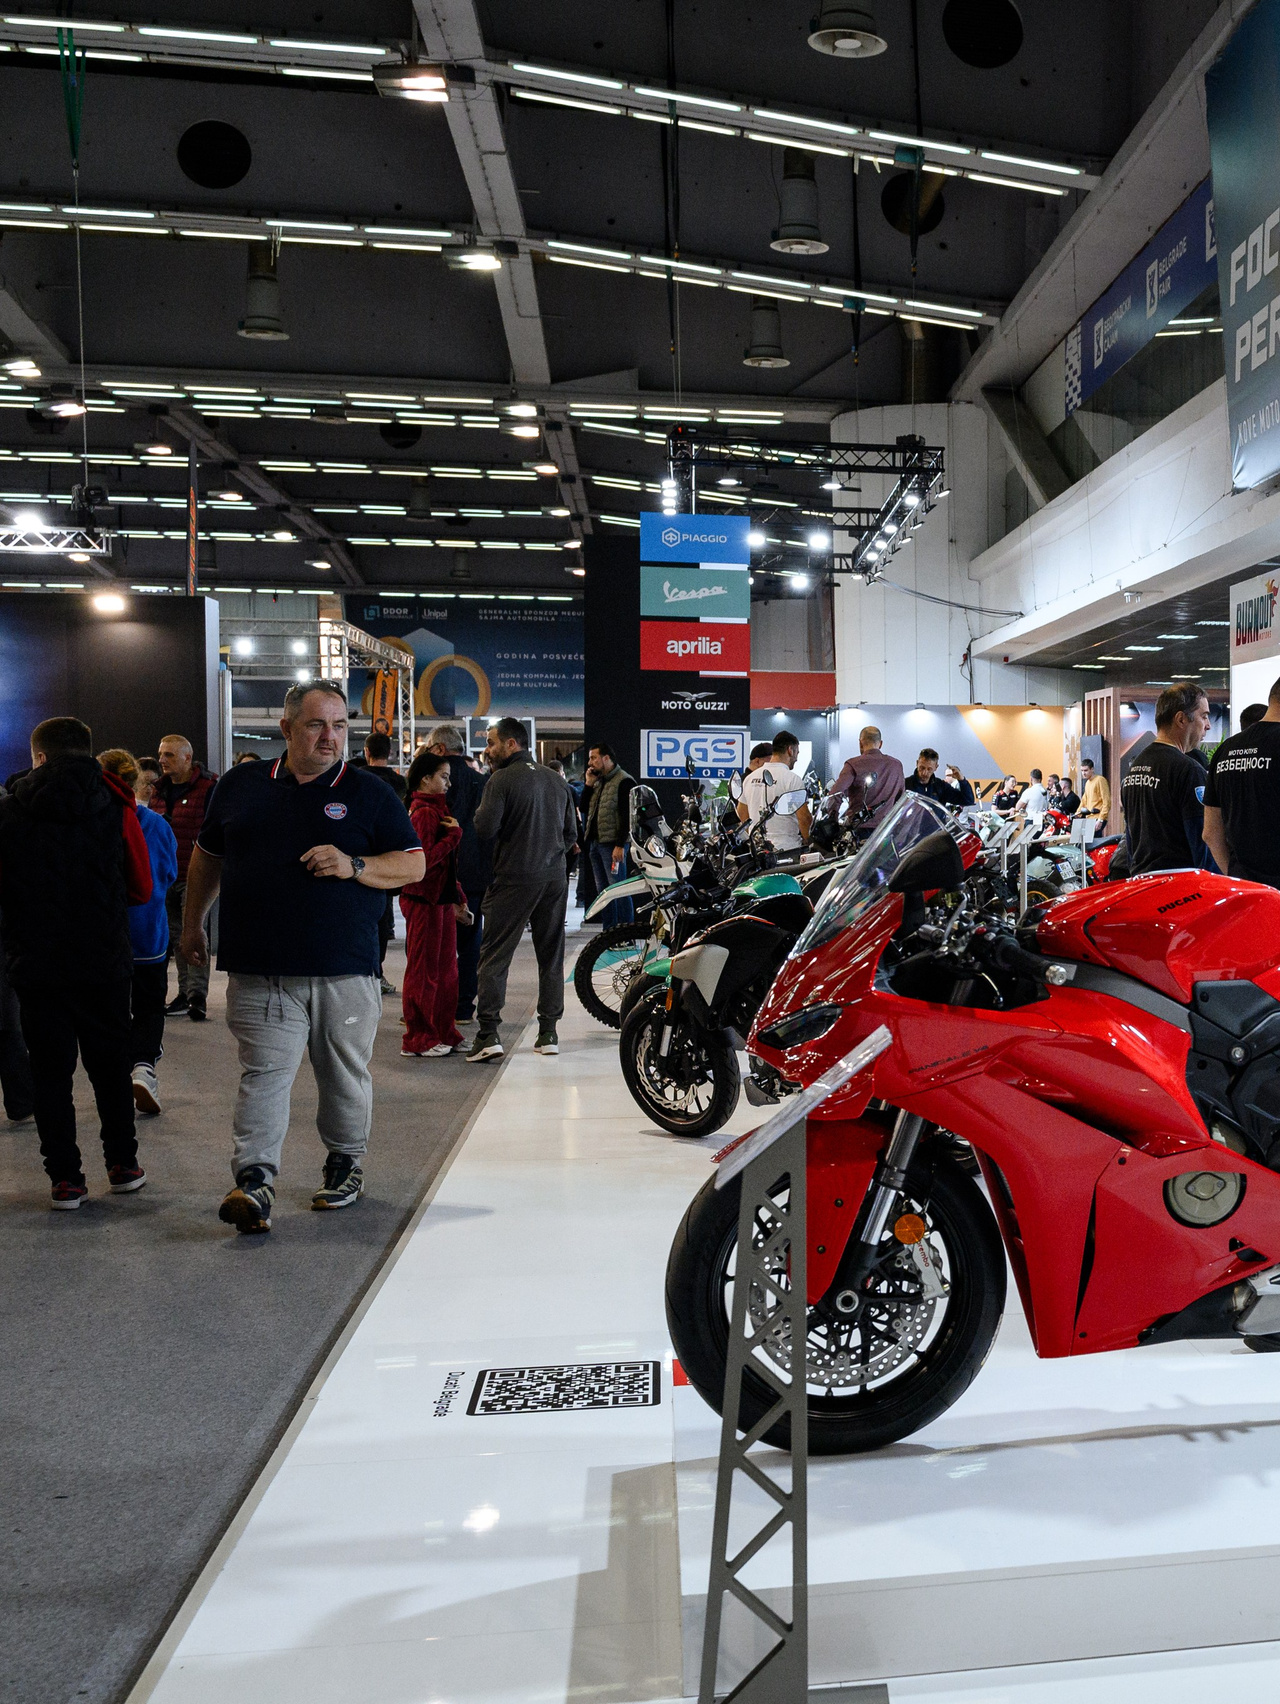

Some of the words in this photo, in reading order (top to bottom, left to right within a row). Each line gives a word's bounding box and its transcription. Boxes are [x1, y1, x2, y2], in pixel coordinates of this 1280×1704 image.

[1159, 236, 1187, 278] BELGRADE
[1159, 275, 1171, 299] FAIR
[1260, 403, 1280, 432] MOTO
[682, 533, 727, 543] PIAGGIO
[663, 581, 727, 603] Vespa
[423, 609, 447, 619] Unipol
[1236, 593, 1274, 646] BURNOUT
[667, 637, 722, 656] aprilia
[661, 701, 691, 709] MOTO
[695, 702, 727, 710] GUZZI
[656, 737, 736, 763] PGS
[1228, 748, 1244, 756] МОТО
[1216, 757, 1271, 774] БЕЗБЕДНОСТ
[1157, 893, 1203, 914] DUCATI
[918, 1241, 930, 1268] rembo
[444, 1371, 465, 1389] Ducati
[433, 1390, 459, 1417] Belgrade
